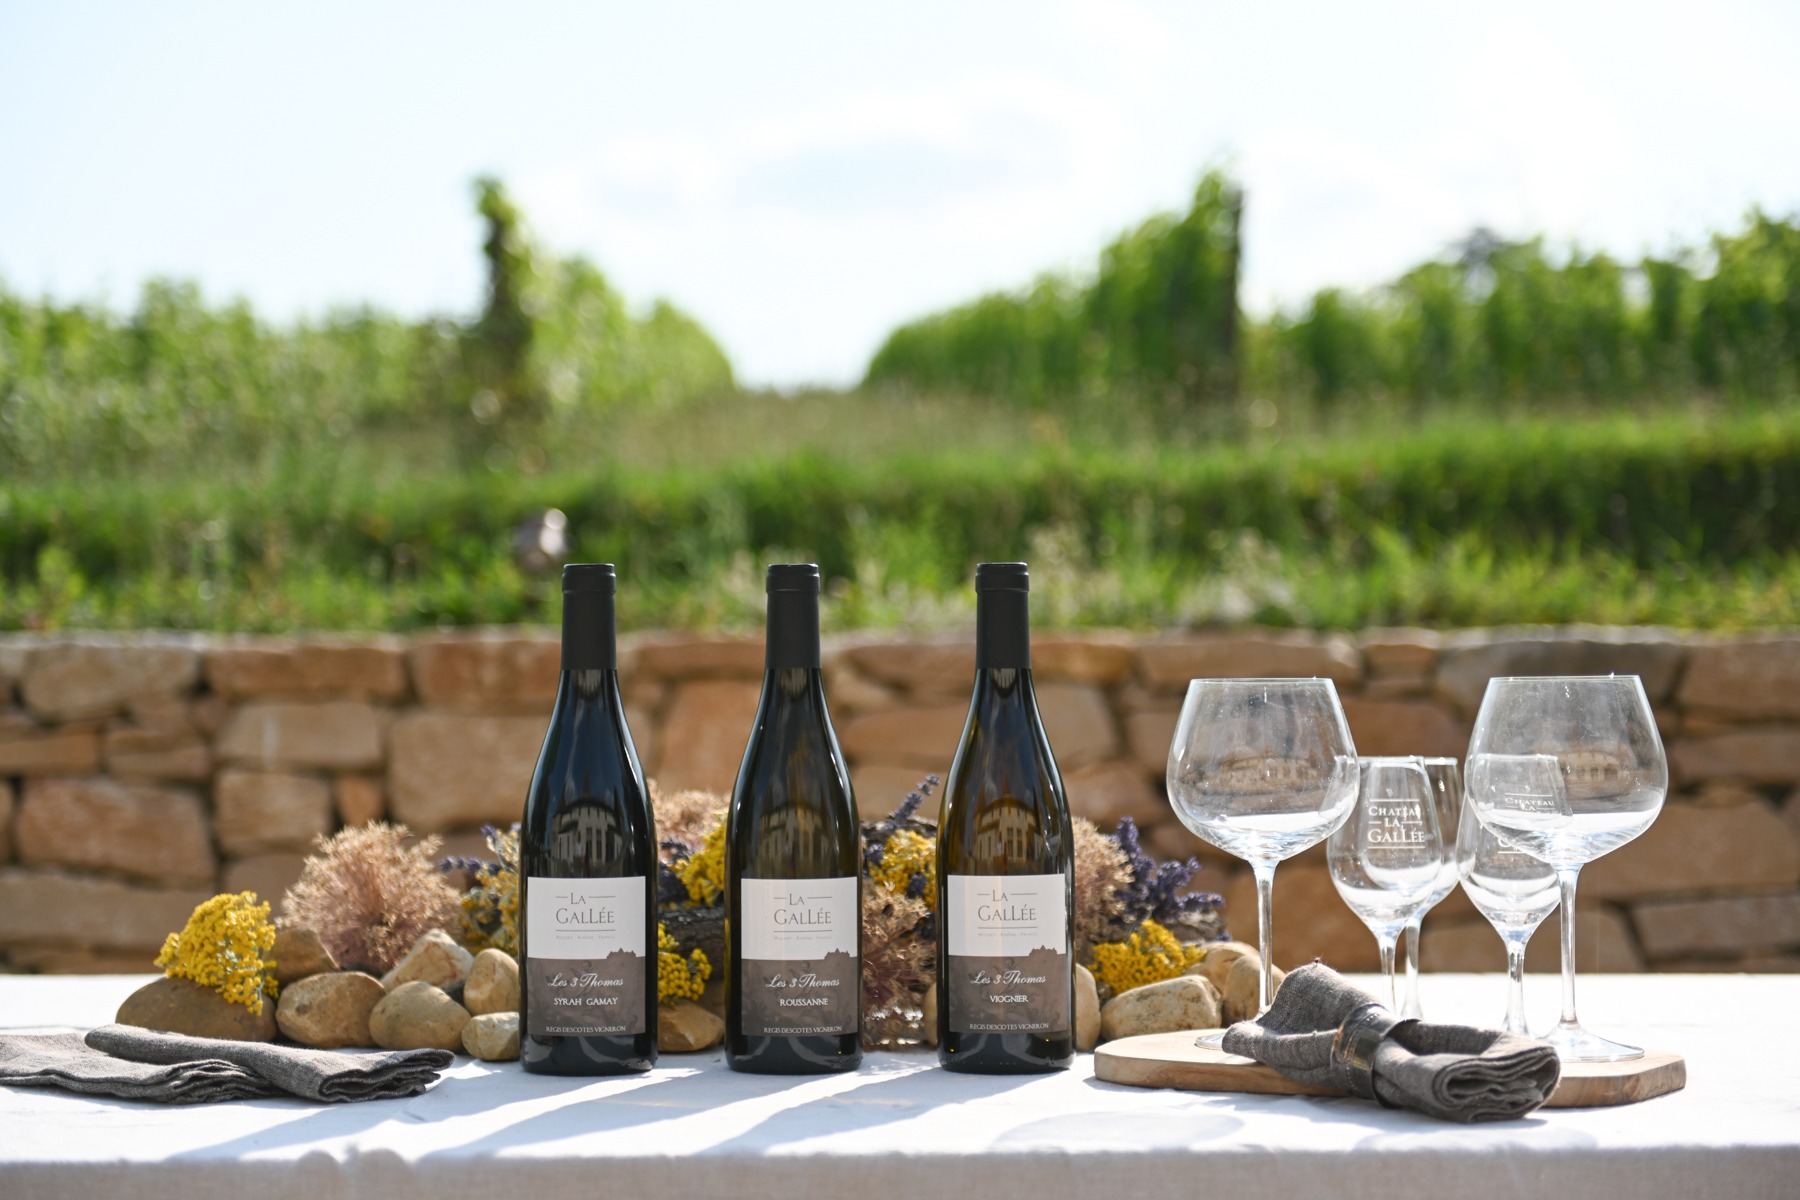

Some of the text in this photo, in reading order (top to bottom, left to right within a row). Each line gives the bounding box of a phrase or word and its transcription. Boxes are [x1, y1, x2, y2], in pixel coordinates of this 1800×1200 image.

[1368, 805, 1421, 817] CHATEA
[1384, 818, 1400, 827] LA
[570, 892, 586, 905] LA
[789, 893, 805, 906] LA
[992, 889, 1008, 902] LA
[548, 972, 624, 987] Les 3 Thomas
[765, 973, 840, 988] Les 3 Thomas
[970, 970, 1047, 984] Les 3 Thomas
[554, 997, 618, 1006] SYRAH GAMAY
[780, 998, 828, 1007] ROUSSANNE
[989, 995, 1029, 1003] VIOGNIER
[594, 1025, 626, 1033] VIGNERON
[813, 1025, 842, 1033] VIGNERON
[1018, 1022, 1049, 1030] VIGNERON
